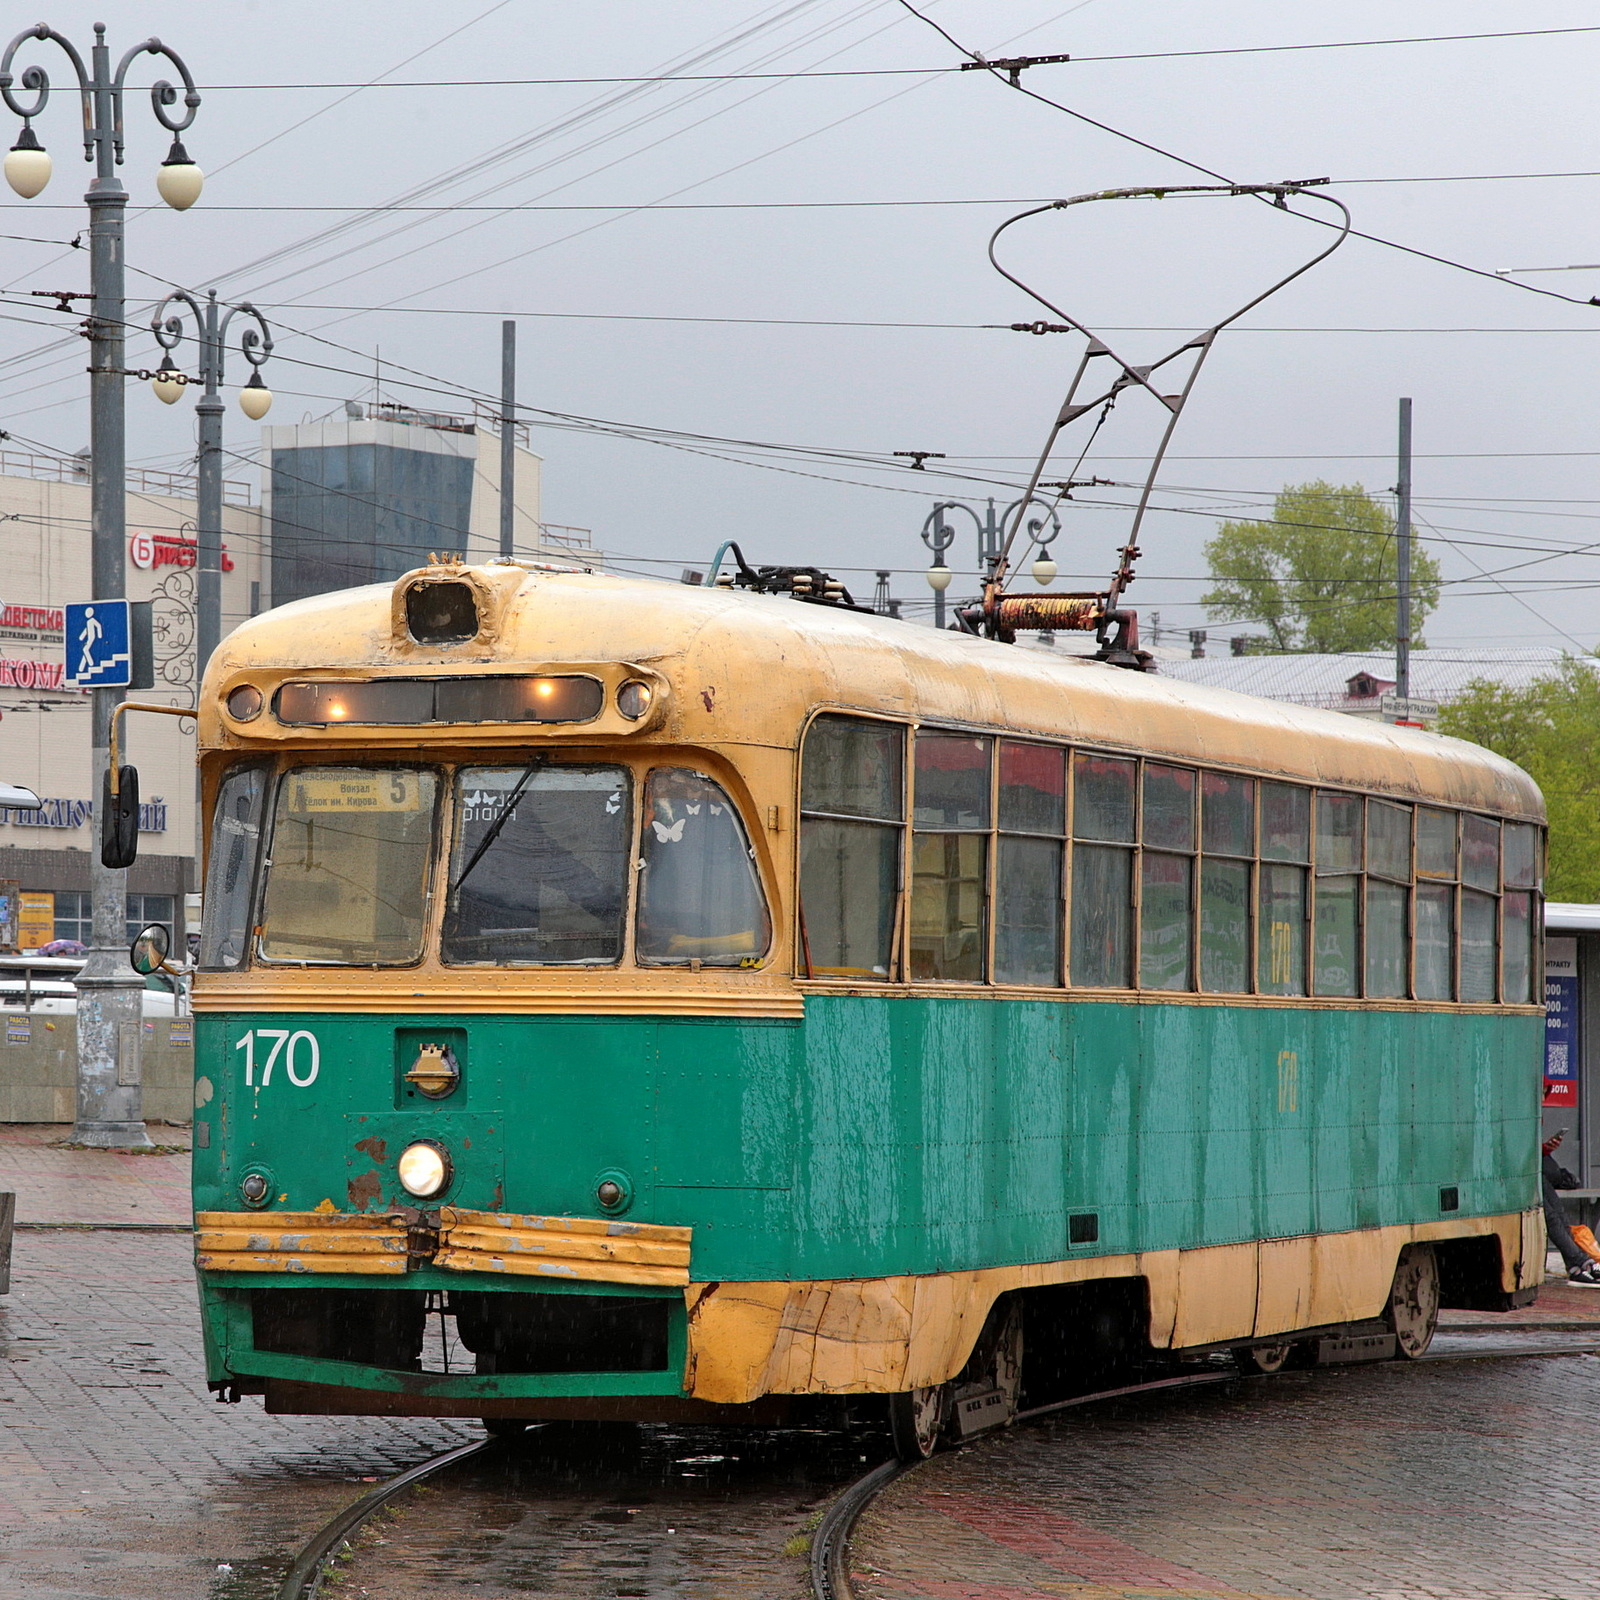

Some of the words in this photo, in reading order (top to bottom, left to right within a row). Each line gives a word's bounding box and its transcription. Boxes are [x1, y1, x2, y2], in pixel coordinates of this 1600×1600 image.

[0, 606, 64, 630] ОВЕТСКА
[330, 798, 344, 806] им.
[347, 797, 378, 807] Кирова
[340, 784, 370, 794] Вокзал
[388, 773, 406, 804] 5
[1271, 921, 1290, 983] 170
[235, 1028, 320, 1087] 170
